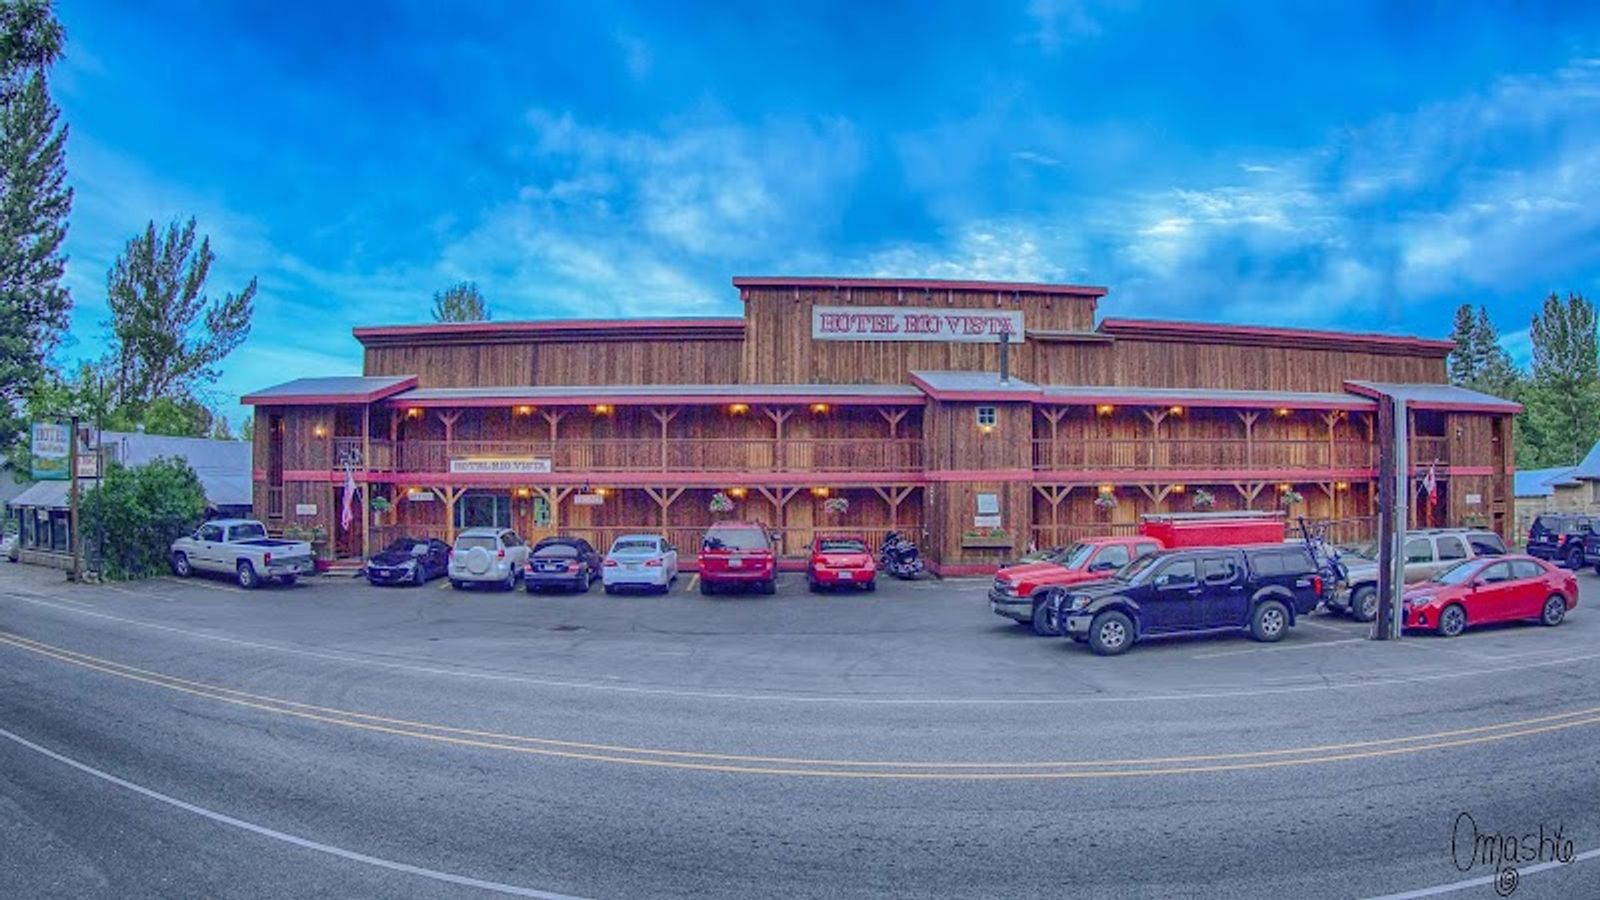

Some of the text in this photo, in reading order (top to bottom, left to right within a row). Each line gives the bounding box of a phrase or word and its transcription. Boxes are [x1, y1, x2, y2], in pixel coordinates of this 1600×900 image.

[820, 313, 1017, 335] HOTEL RIO VISTA
[492, 460, 511, 471] RIO
